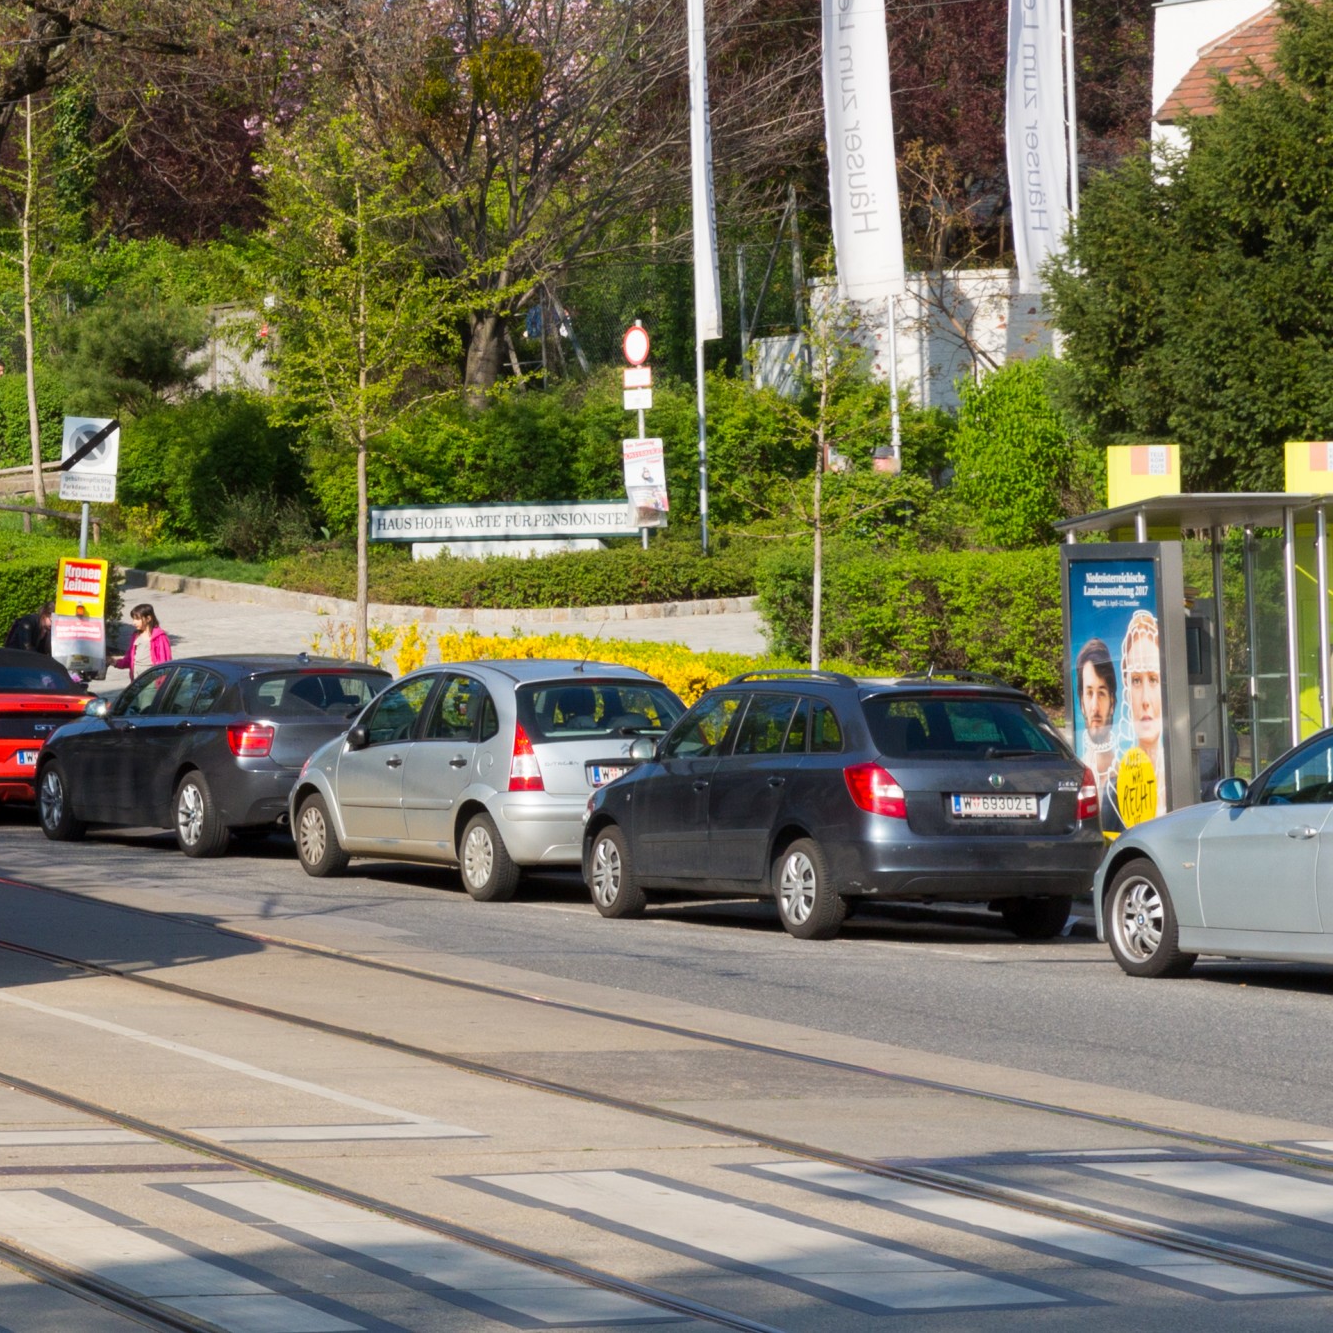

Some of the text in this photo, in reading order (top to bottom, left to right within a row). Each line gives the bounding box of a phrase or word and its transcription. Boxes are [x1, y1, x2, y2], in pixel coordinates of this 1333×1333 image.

[377, 516, 412, 531] HAUS
[415, 514, 452, 529] HOHE
[455, 514, 502, 528] WARTE
[505, 512, 531, 528] FÜR
[64, 564, 101, 580] Kronen
[63, 578, 100, 595] Zeitung
[1135, 585, 1149, 596] 2017
[1122, 779, 1155, 821] RECHT
